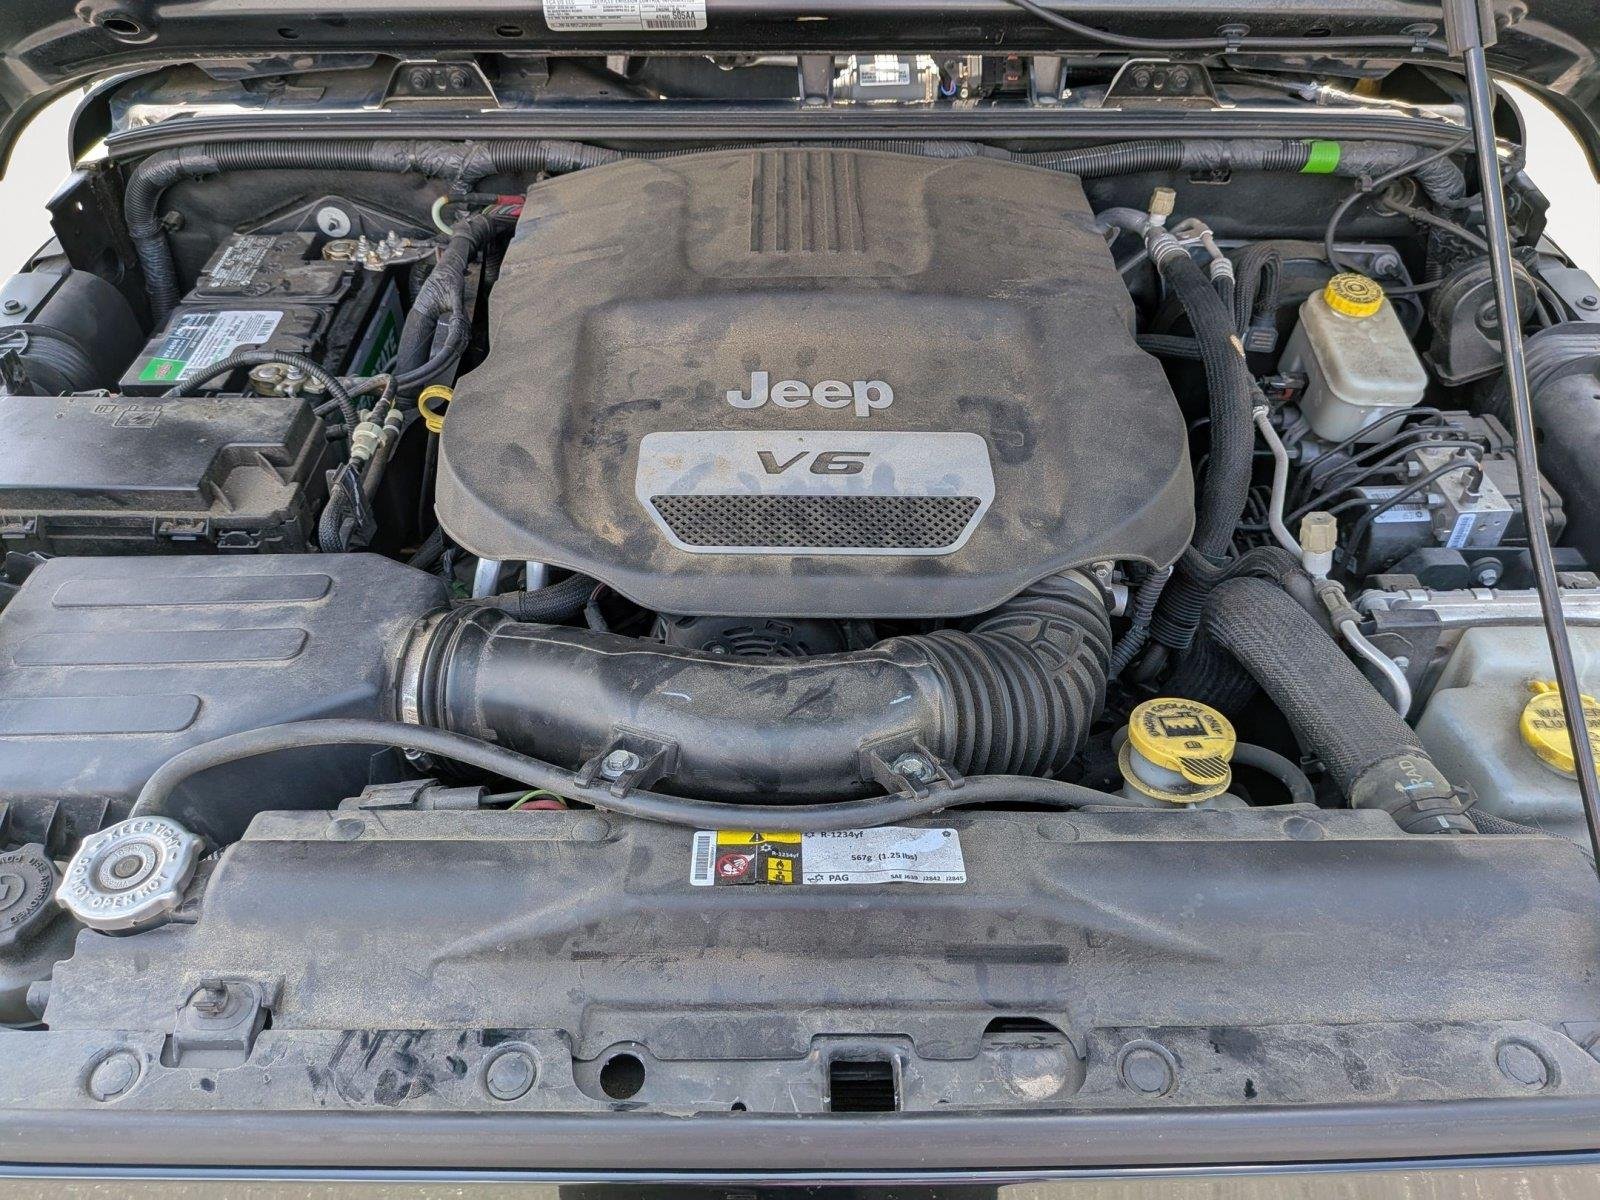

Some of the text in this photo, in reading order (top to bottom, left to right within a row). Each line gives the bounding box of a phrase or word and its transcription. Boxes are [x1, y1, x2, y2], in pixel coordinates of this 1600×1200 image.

[672, 11, 695, 20] 505AA
[726, 371, 894, 417] Jeep
[757, 451, 871, 474] V6
[1151, 703, 1203, 714] COOLANT
[108, 821, 182, 849] KEEP TIGHT
[820, 830, 864, 840] R-1234yf
[851, 852, 918, 862] 567g (1.25 lbs)
[829, 874, 849, 882] PAG
[72, 878, 95, 901] NOT
[91, 893, 136, 909] OPEN
[137, 871, 168, 898] HOT
[11, 874, 50, 924] APPROVED
